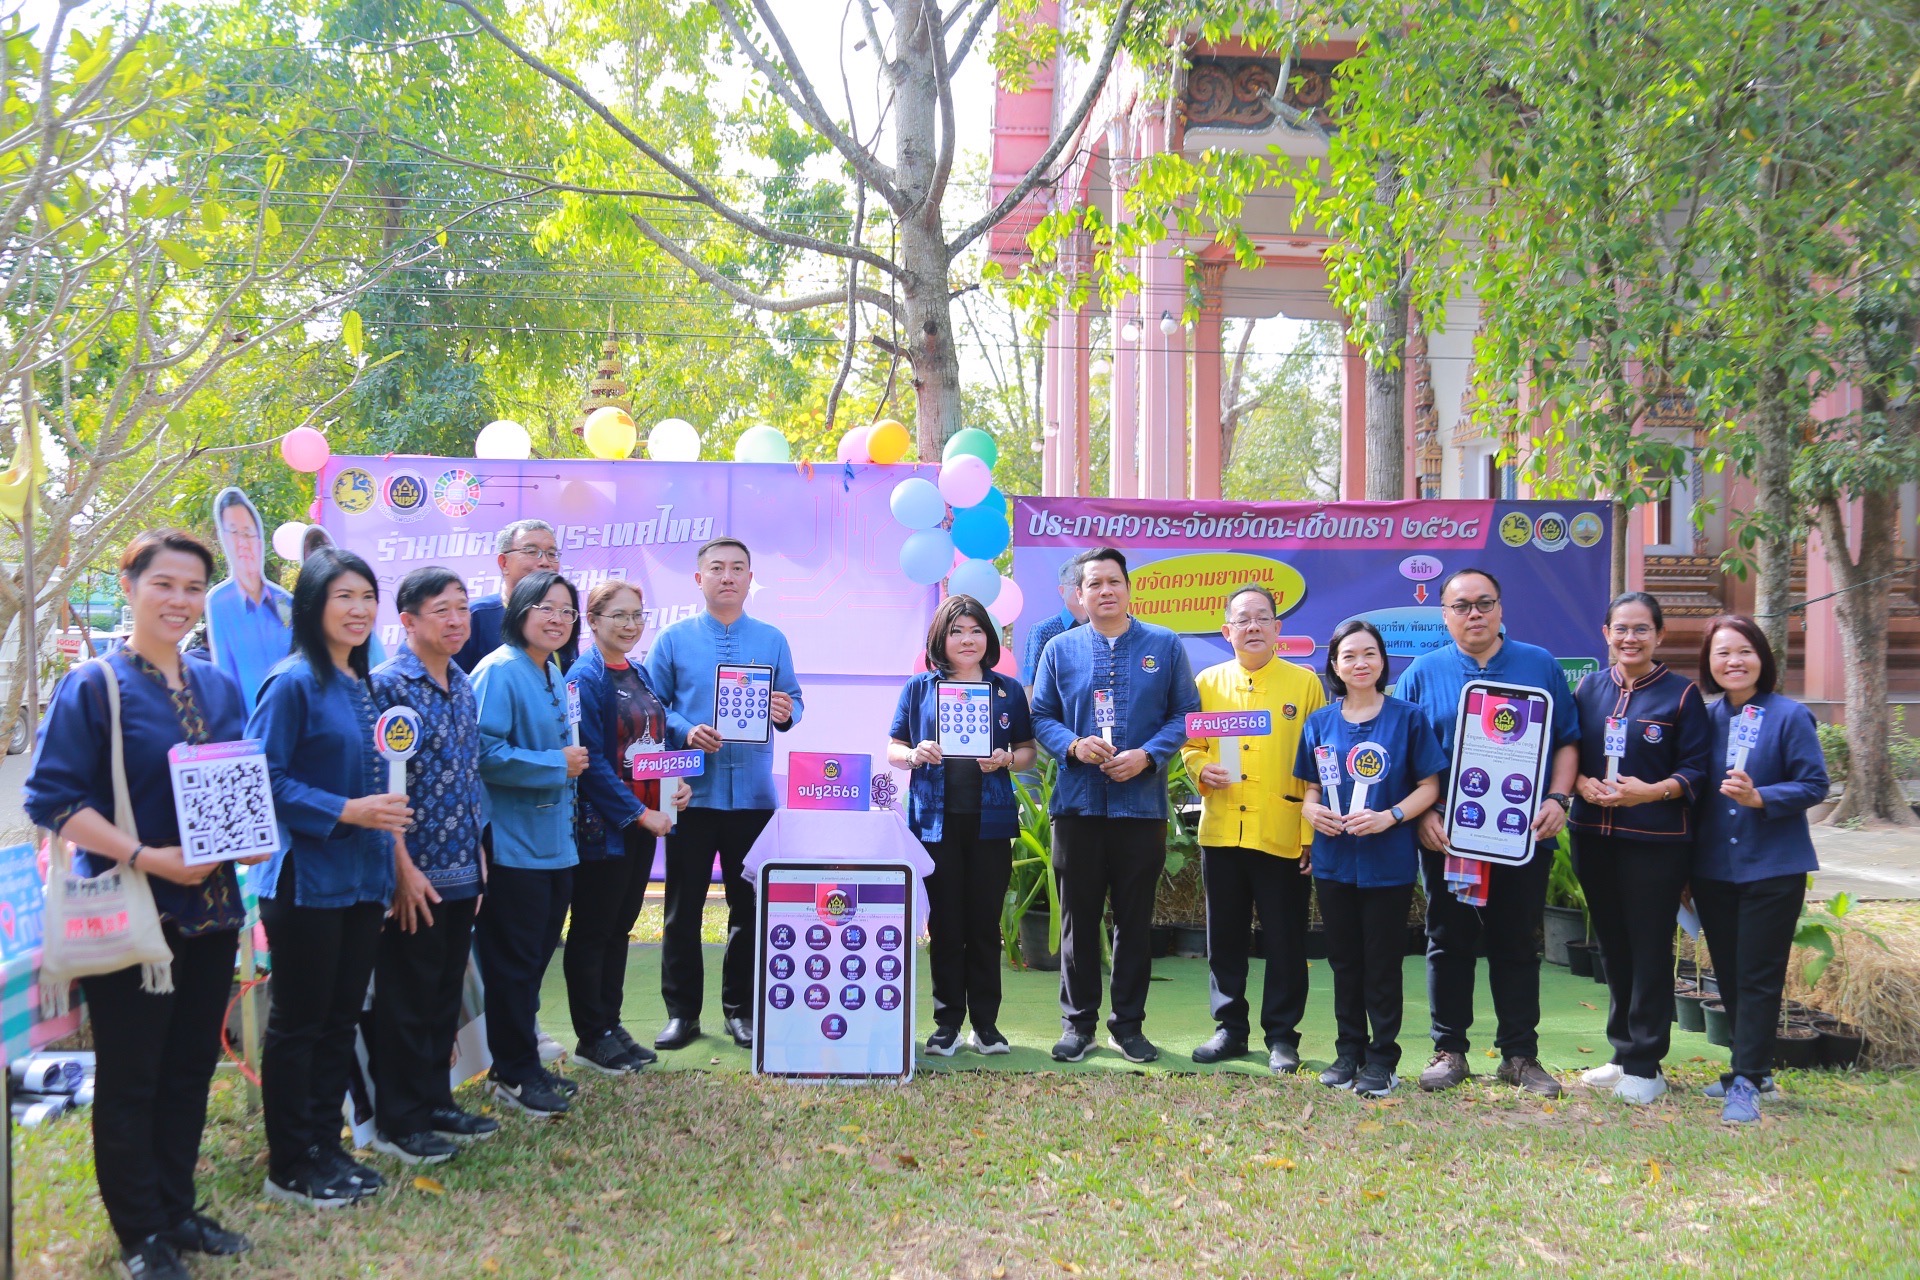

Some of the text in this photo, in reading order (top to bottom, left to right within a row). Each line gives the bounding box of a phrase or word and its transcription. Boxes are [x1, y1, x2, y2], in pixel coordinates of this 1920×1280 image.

[1028, 509, 1479, 539] ประกาศวาระจังหวัดฉะเชิงเทรา ๒๕๖๘
[1410, 560, 1432, 574] ชี้เป้า
[1135, 567, 1274, 592] ขจัดความยากจน
[1191, 715, 1267, 733] #จปฐ2568
[637, 755, 701, 774] #จปฐ2568
[797, 783, 860, 800] จปฐ2568
